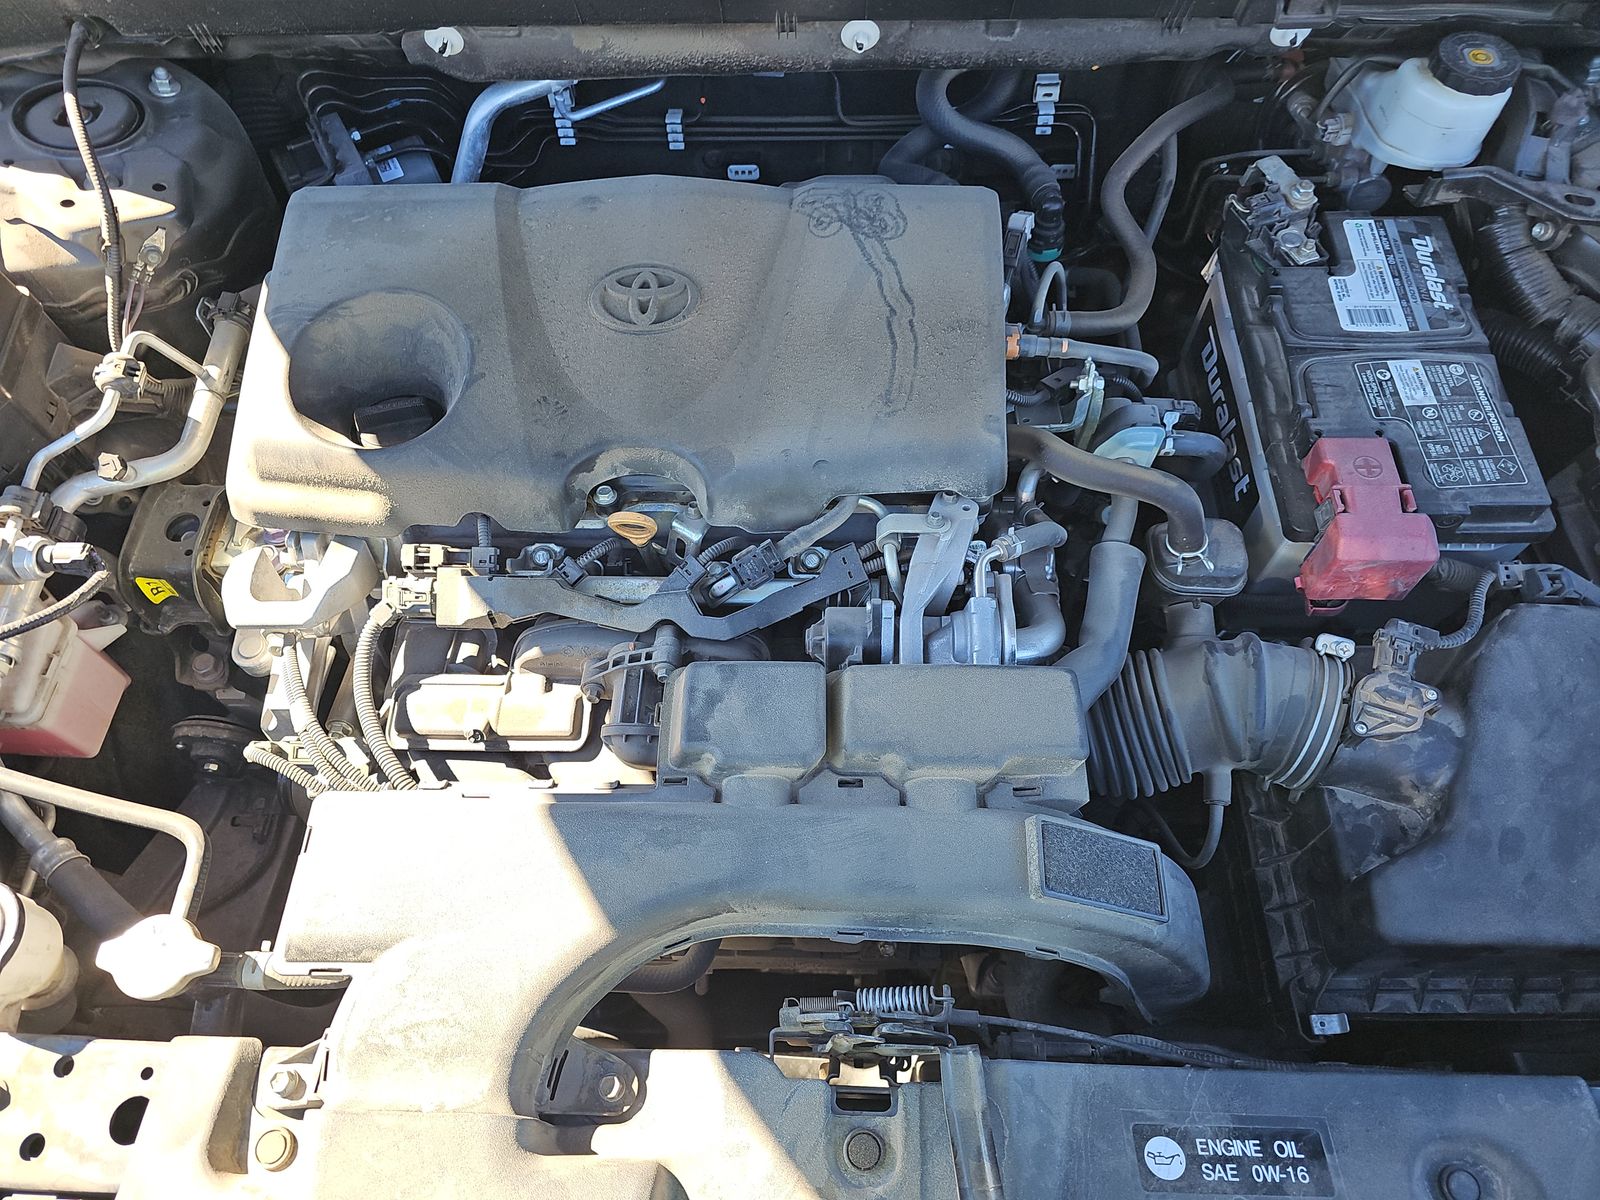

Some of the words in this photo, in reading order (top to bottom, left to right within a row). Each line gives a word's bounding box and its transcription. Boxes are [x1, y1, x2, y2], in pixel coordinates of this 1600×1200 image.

[1397, 256, 1419, 304] TECHNOLOGY
[1410, 235, 1454, 310] Duralast
[1200, 325, 1251, 502] Duralast
[1472, 380, 1506, 441] DANGER/POISON
[1195, 1138, 1263, 1157] ENGINE
[1273, 1140, 1305, 1158] OIL
[1201, 1163, 1239, 1182] SAE
[1252, 1165, 1309, 1183] 0W-16
